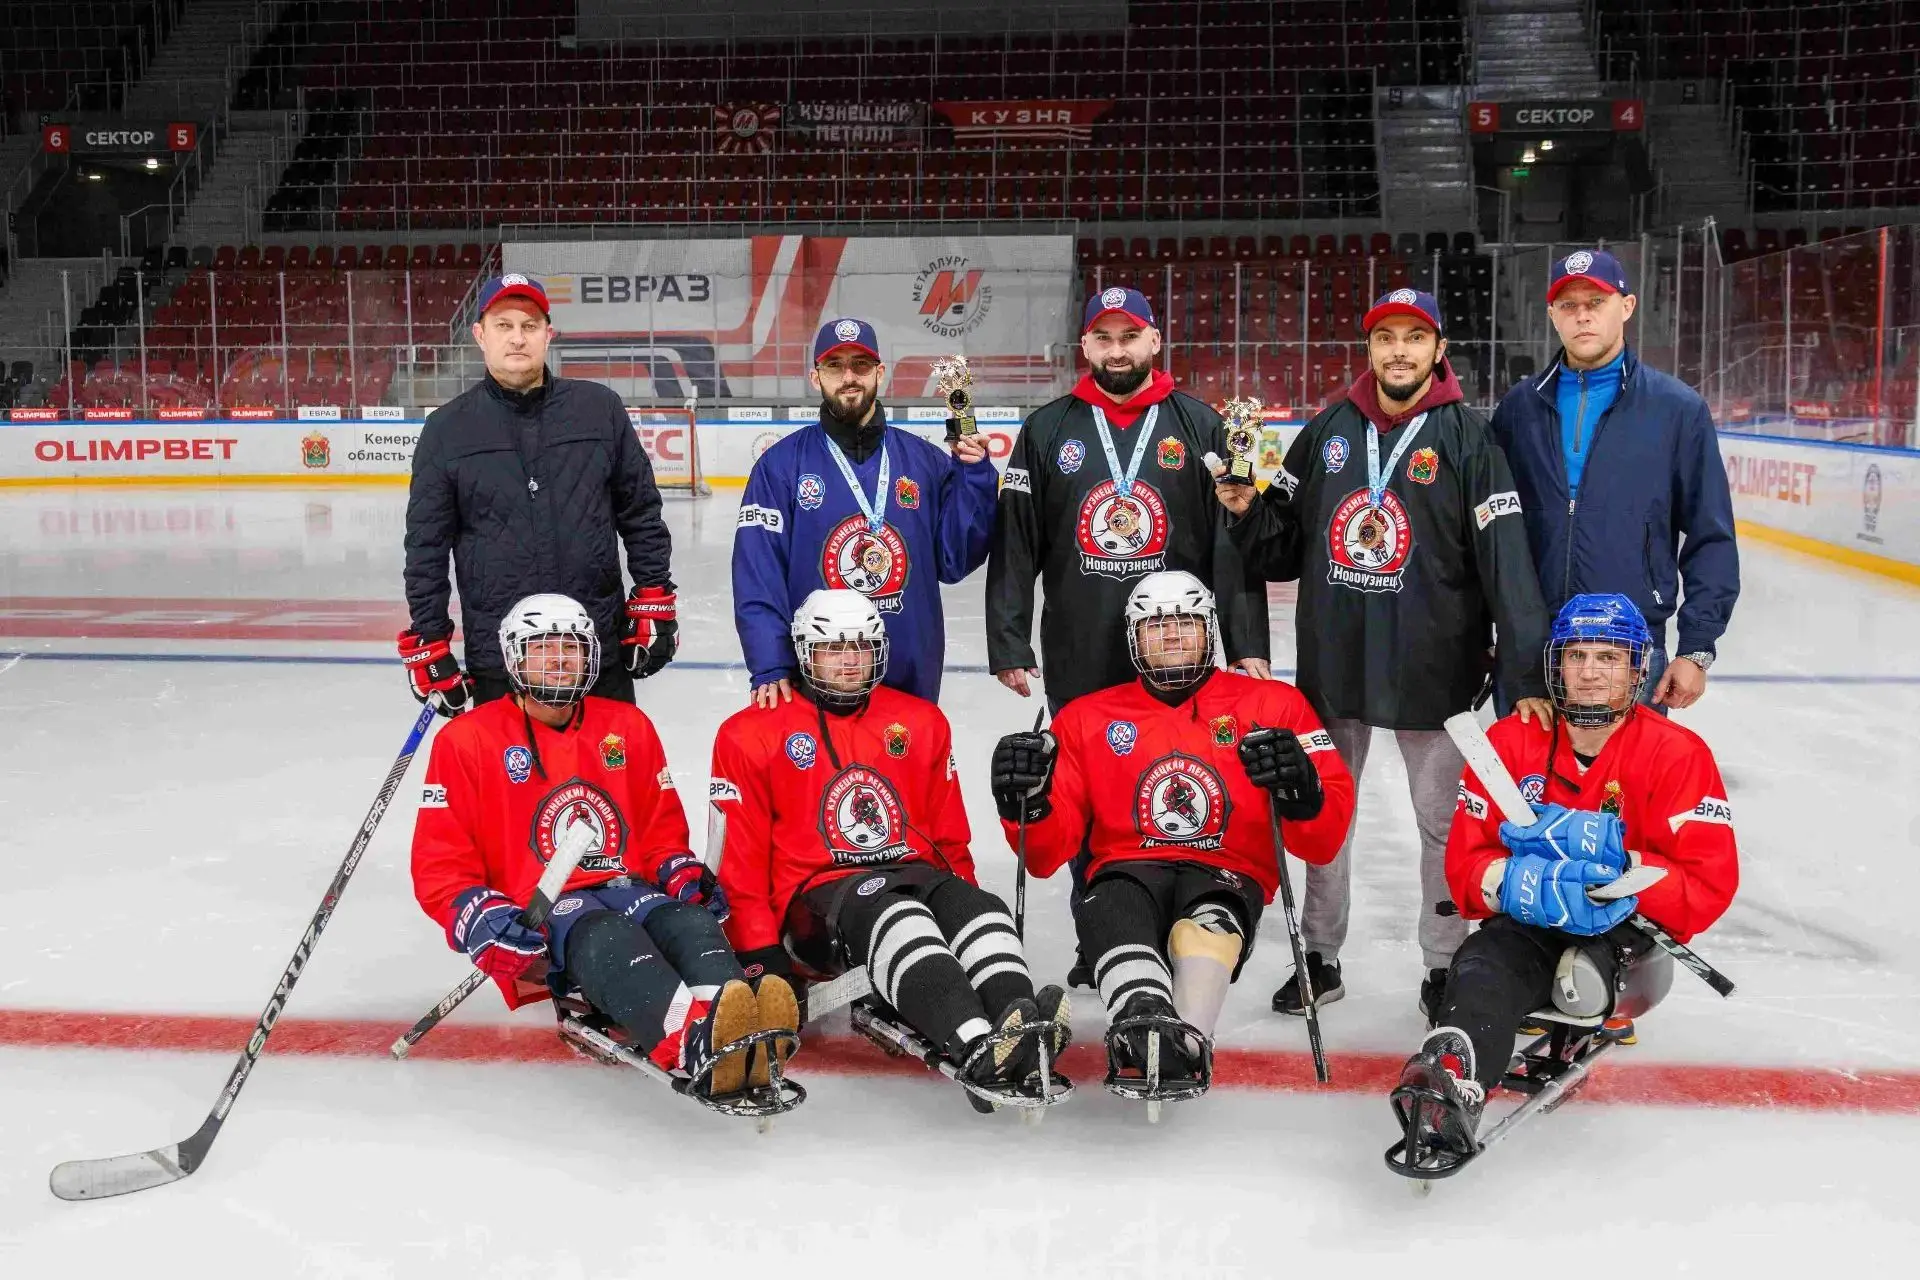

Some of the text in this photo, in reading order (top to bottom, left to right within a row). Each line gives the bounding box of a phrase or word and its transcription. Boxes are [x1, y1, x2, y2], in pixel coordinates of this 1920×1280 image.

[971, 109, 1072, 125] КУЗНЯ
[1478, 106, 1635, 125] 5 СЕКТОР 4
[50, 129, 188, 147] 6 СЕКТОР 5
[580, 274, 710, 305] ЕВРАЗ
[911, 255, 969, 302] МЕТАЛЛУРГ
[12, 411, 58, 420] OLIMPBET
[87, 410, 131, 418] OLIMPBET
[160, 410, 204, 418] OLIMPBET
[34, 439, 238, 462] OLIMPBET
[1727, 455, 1817, 506] OLIMPBET
[880, 526, 904, 556] ЕГИОН
[826, 771, 865, 811] КУЗНЕЦКИЙ
[1141, 759, 1220, 799] КУЗНЕЦКИЙ ЛЕГИОН
[540, 785, 585, 829] КУЗНЕЦКИЙ
[344, 798, 387, 877] classic SPR
[247, 921, 322, 1060] SOYUZ
